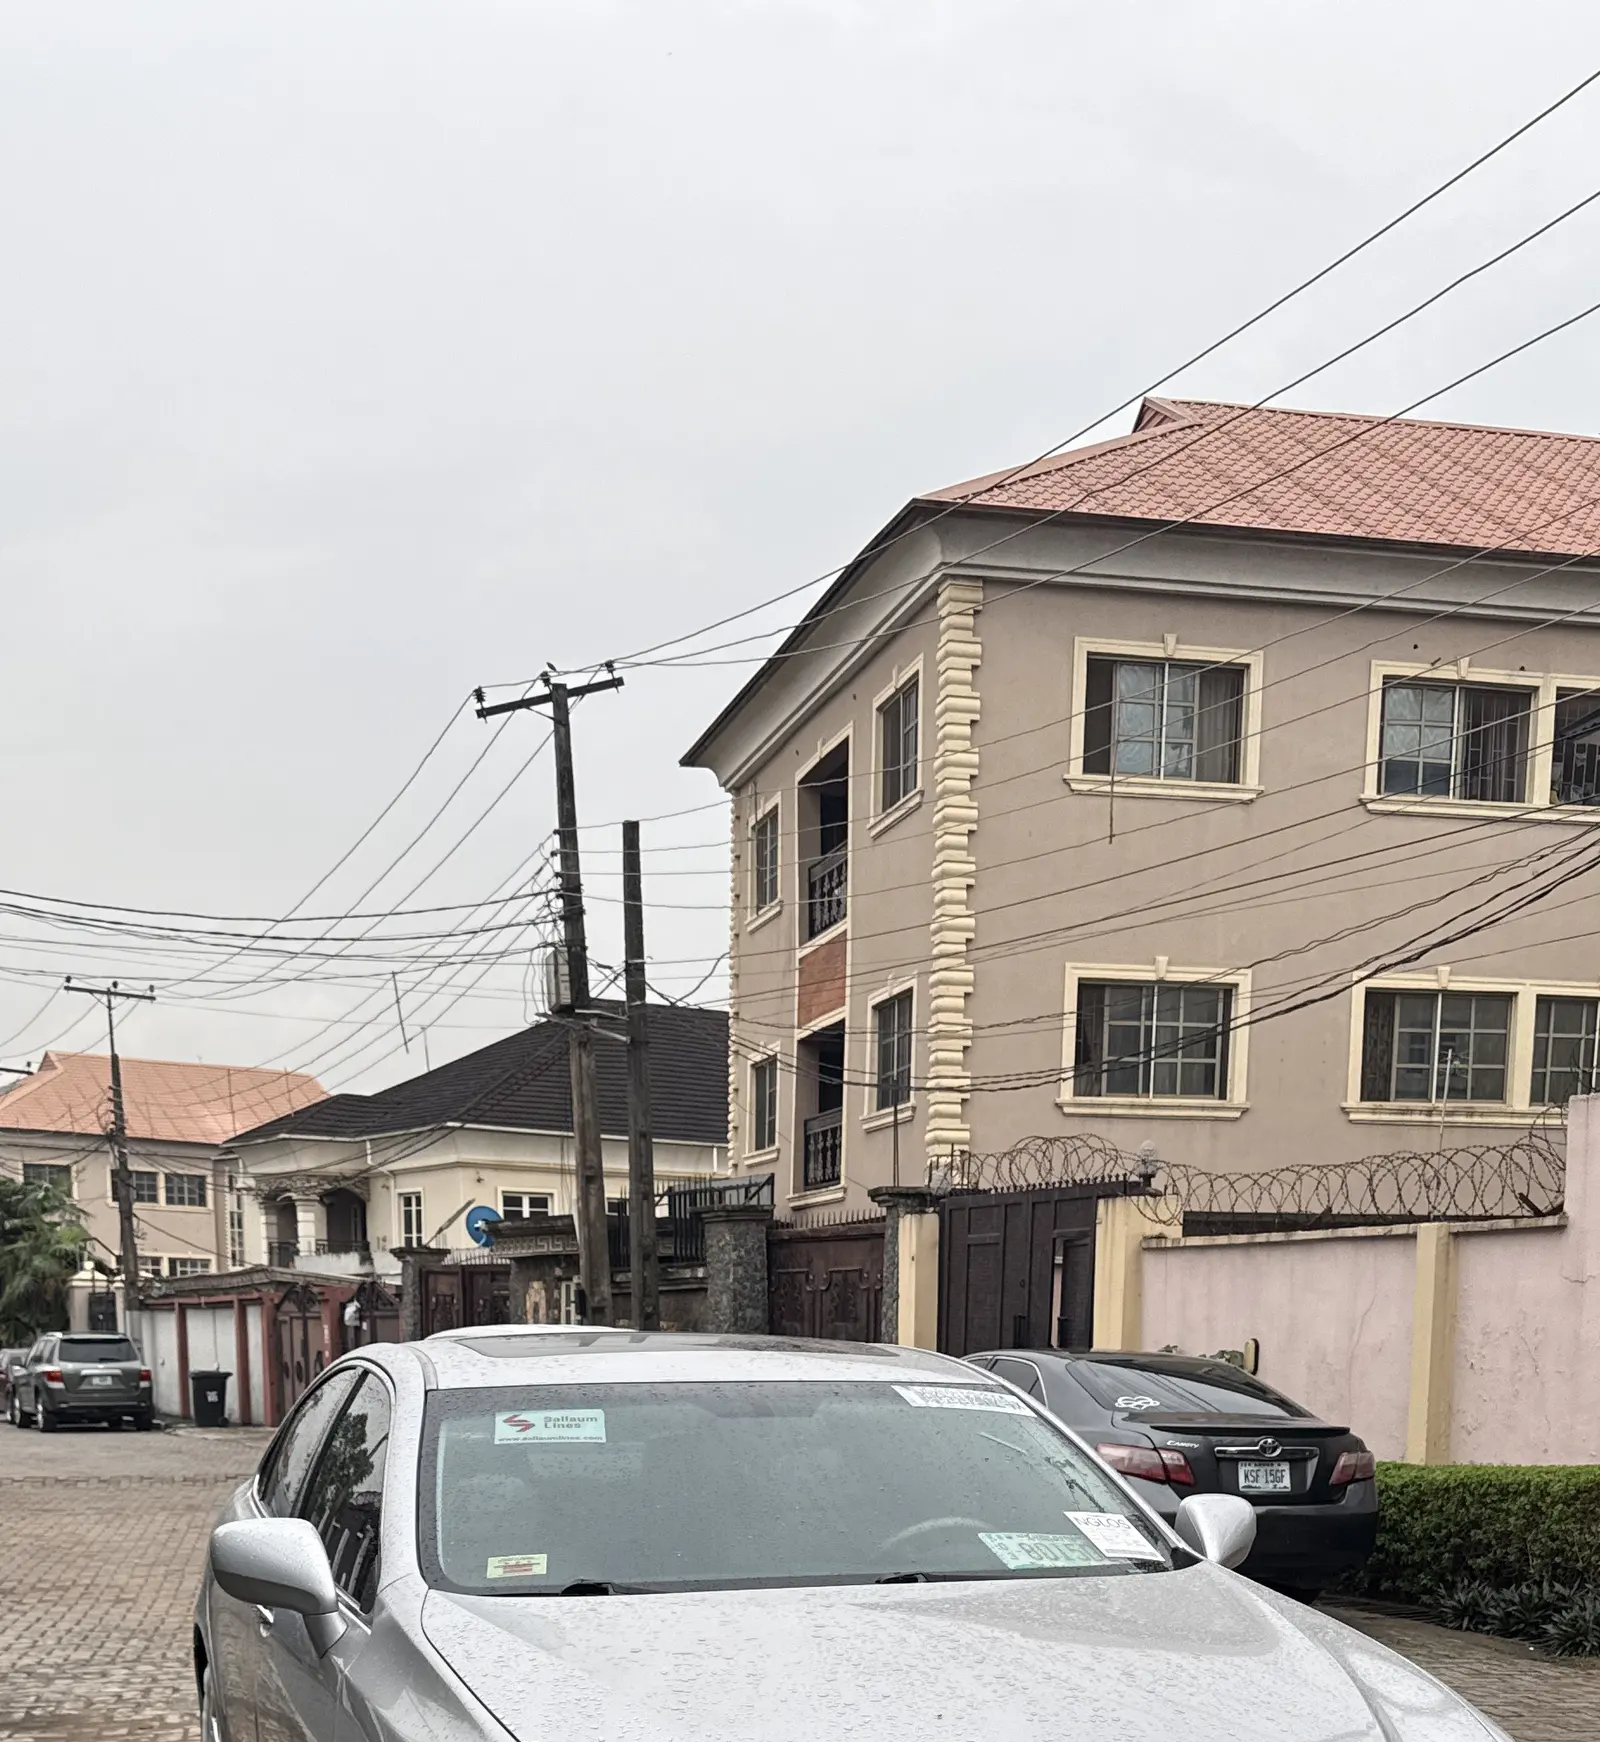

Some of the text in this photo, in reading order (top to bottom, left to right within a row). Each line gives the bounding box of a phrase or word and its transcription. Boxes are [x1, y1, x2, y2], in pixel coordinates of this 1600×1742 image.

[543, 1415, 598, 1423] Sallaum
[1243, 1468, 1261, 1484] KSF
[1073, 1515, 1132, 1530] NGLOS
